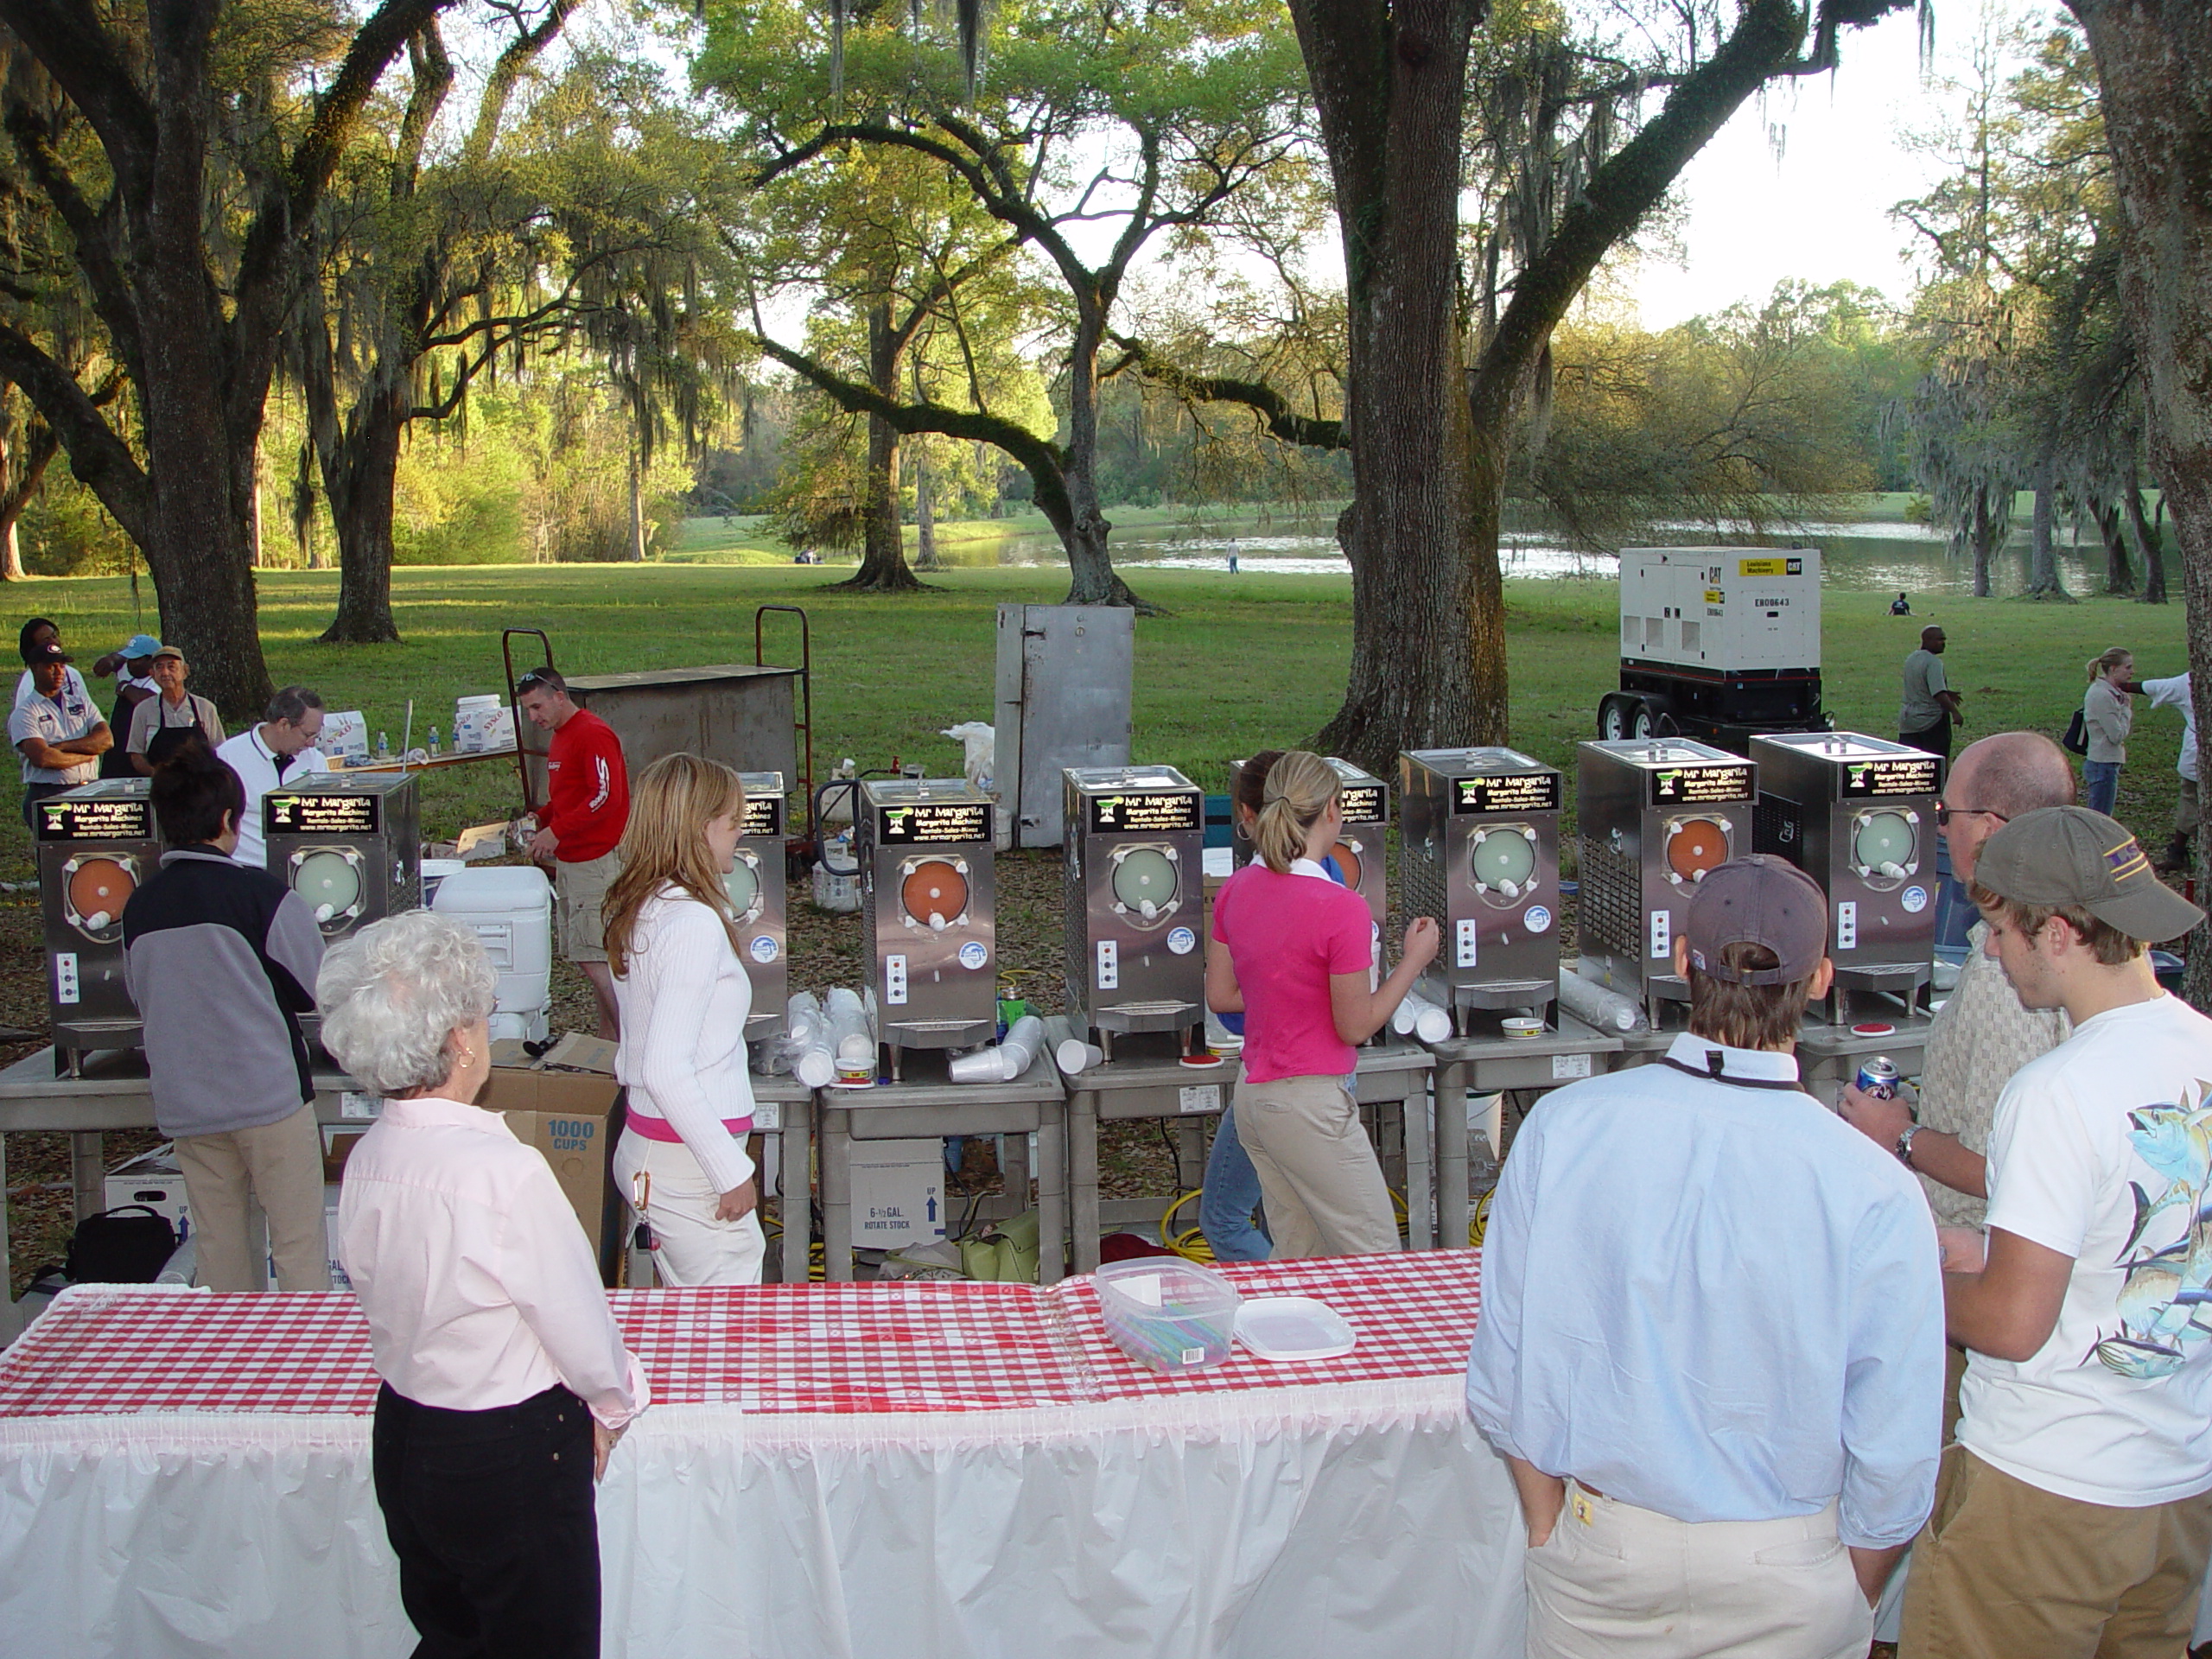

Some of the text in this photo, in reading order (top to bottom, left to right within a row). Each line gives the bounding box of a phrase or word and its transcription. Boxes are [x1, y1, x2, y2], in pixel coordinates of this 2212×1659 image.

[1788, 562, 1802, 571] CAT
[1709, 566, 1721, 583] CAT
[1873, 760, 1936, 773] Mr Margarita
[1683, 766, 1747, 780] Mr Margarita
[1486, 776, 1551, 788] Mr Margarita
[1684, 779, 1716, 788] Margarita
[1872, 785, 1936, 794] www.mrmargarita.net
[1682, 792, 1748, 801] www.mrmargarita.net
[301, 797, 371, 810] Mr Margarita
[1125, 796, 1192, 808] Mr Margarita
[1484, 801, 1553, 810] www.mrmargarita.net
[73, 803, 143, 816] Mr Margarita
[302, 809, 336, 817] Margarita
[915, 806, 984, 819] Mr Margarita
[1126, 808, 1159, 817] Margarita
[74, 815, 109, 823] Margarita
[916, 819, 950, 828] Margarita
[1123, 821, 1193, 830] www.mrmargarita.net
[73, 830, 145, 838] www.mrmargarita.net
[913, 832, 985, 842] www.mrmargarita.net
[548, 1120, 594, 1139] 1000
[553, 1138, 587, 1151] CUPS
